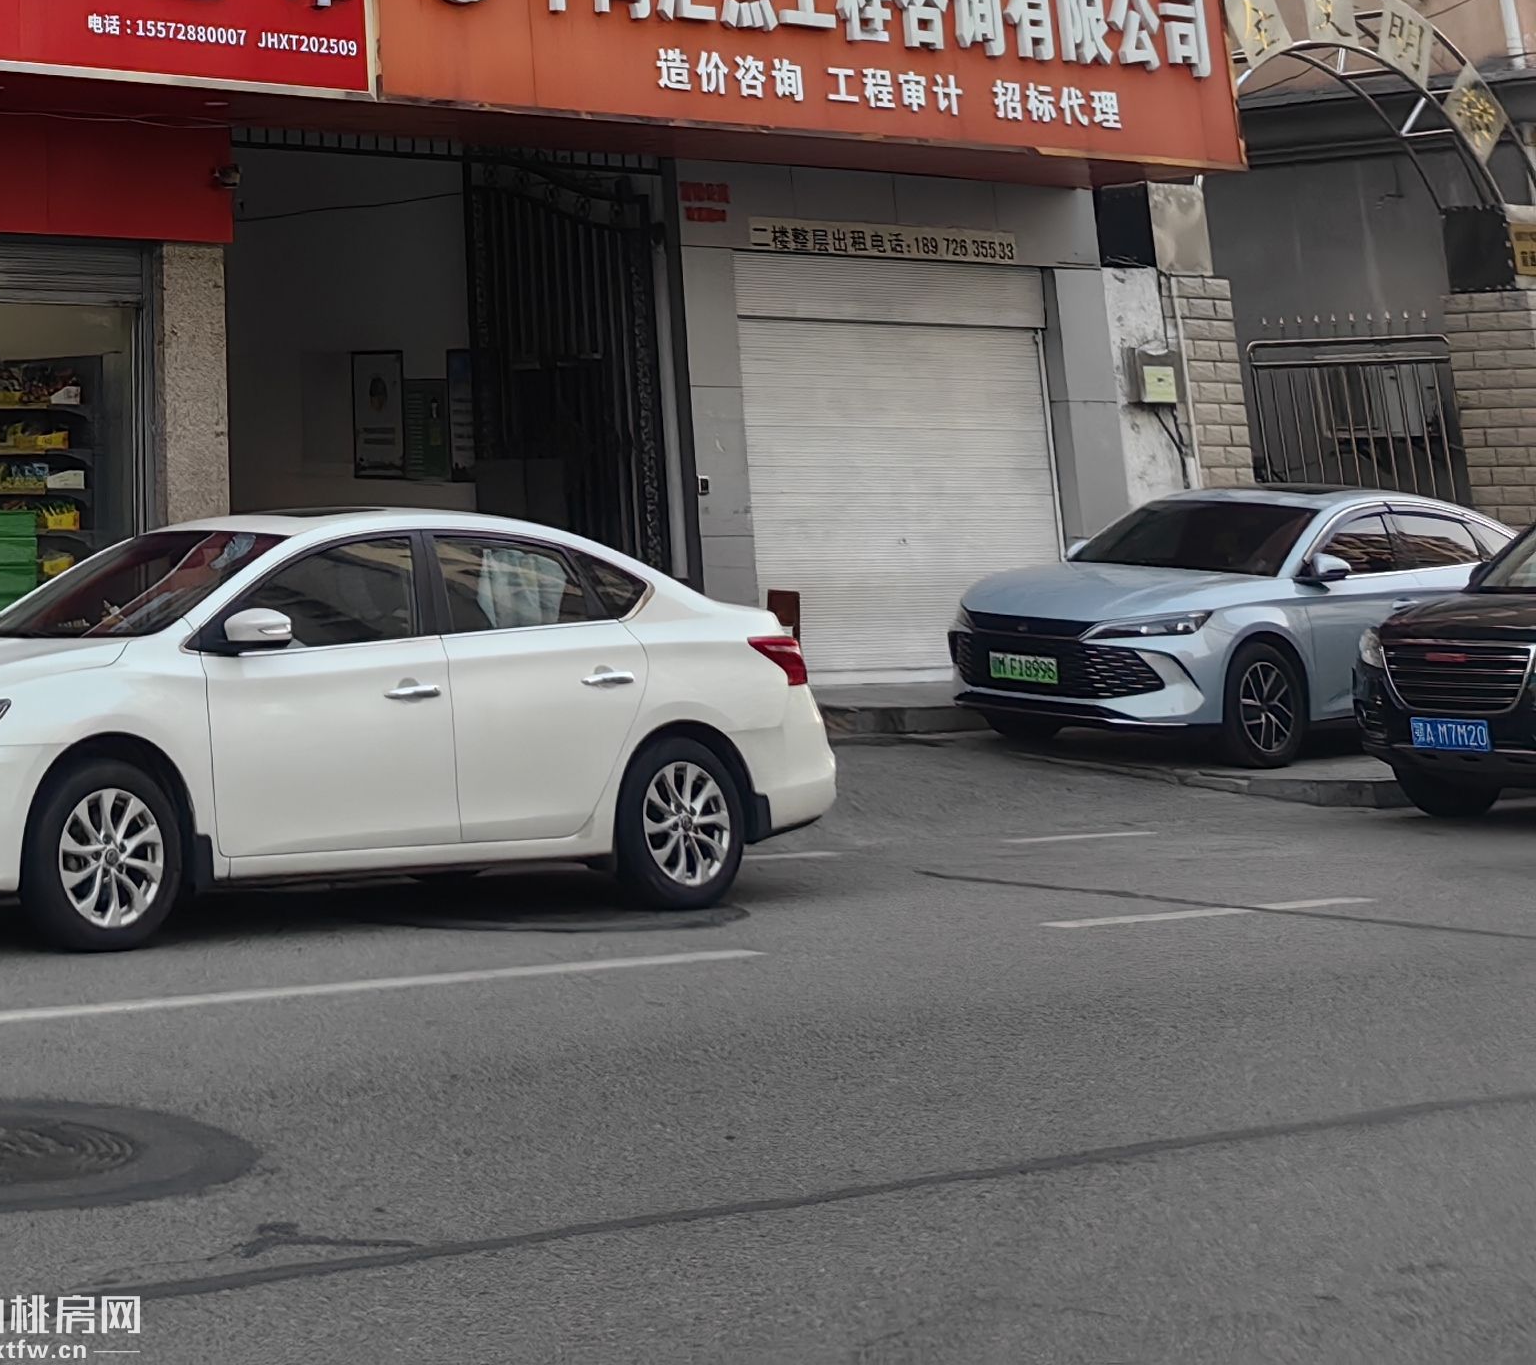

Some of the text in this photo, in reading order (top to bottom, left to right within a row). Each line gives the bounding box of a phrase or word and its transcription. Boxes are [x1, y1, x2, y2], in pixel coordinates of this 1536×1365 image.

[257, 31, 358, 57] JHXT202509
[656, 47, 1123, 130] 造价咨询 工程审计 招标代理
